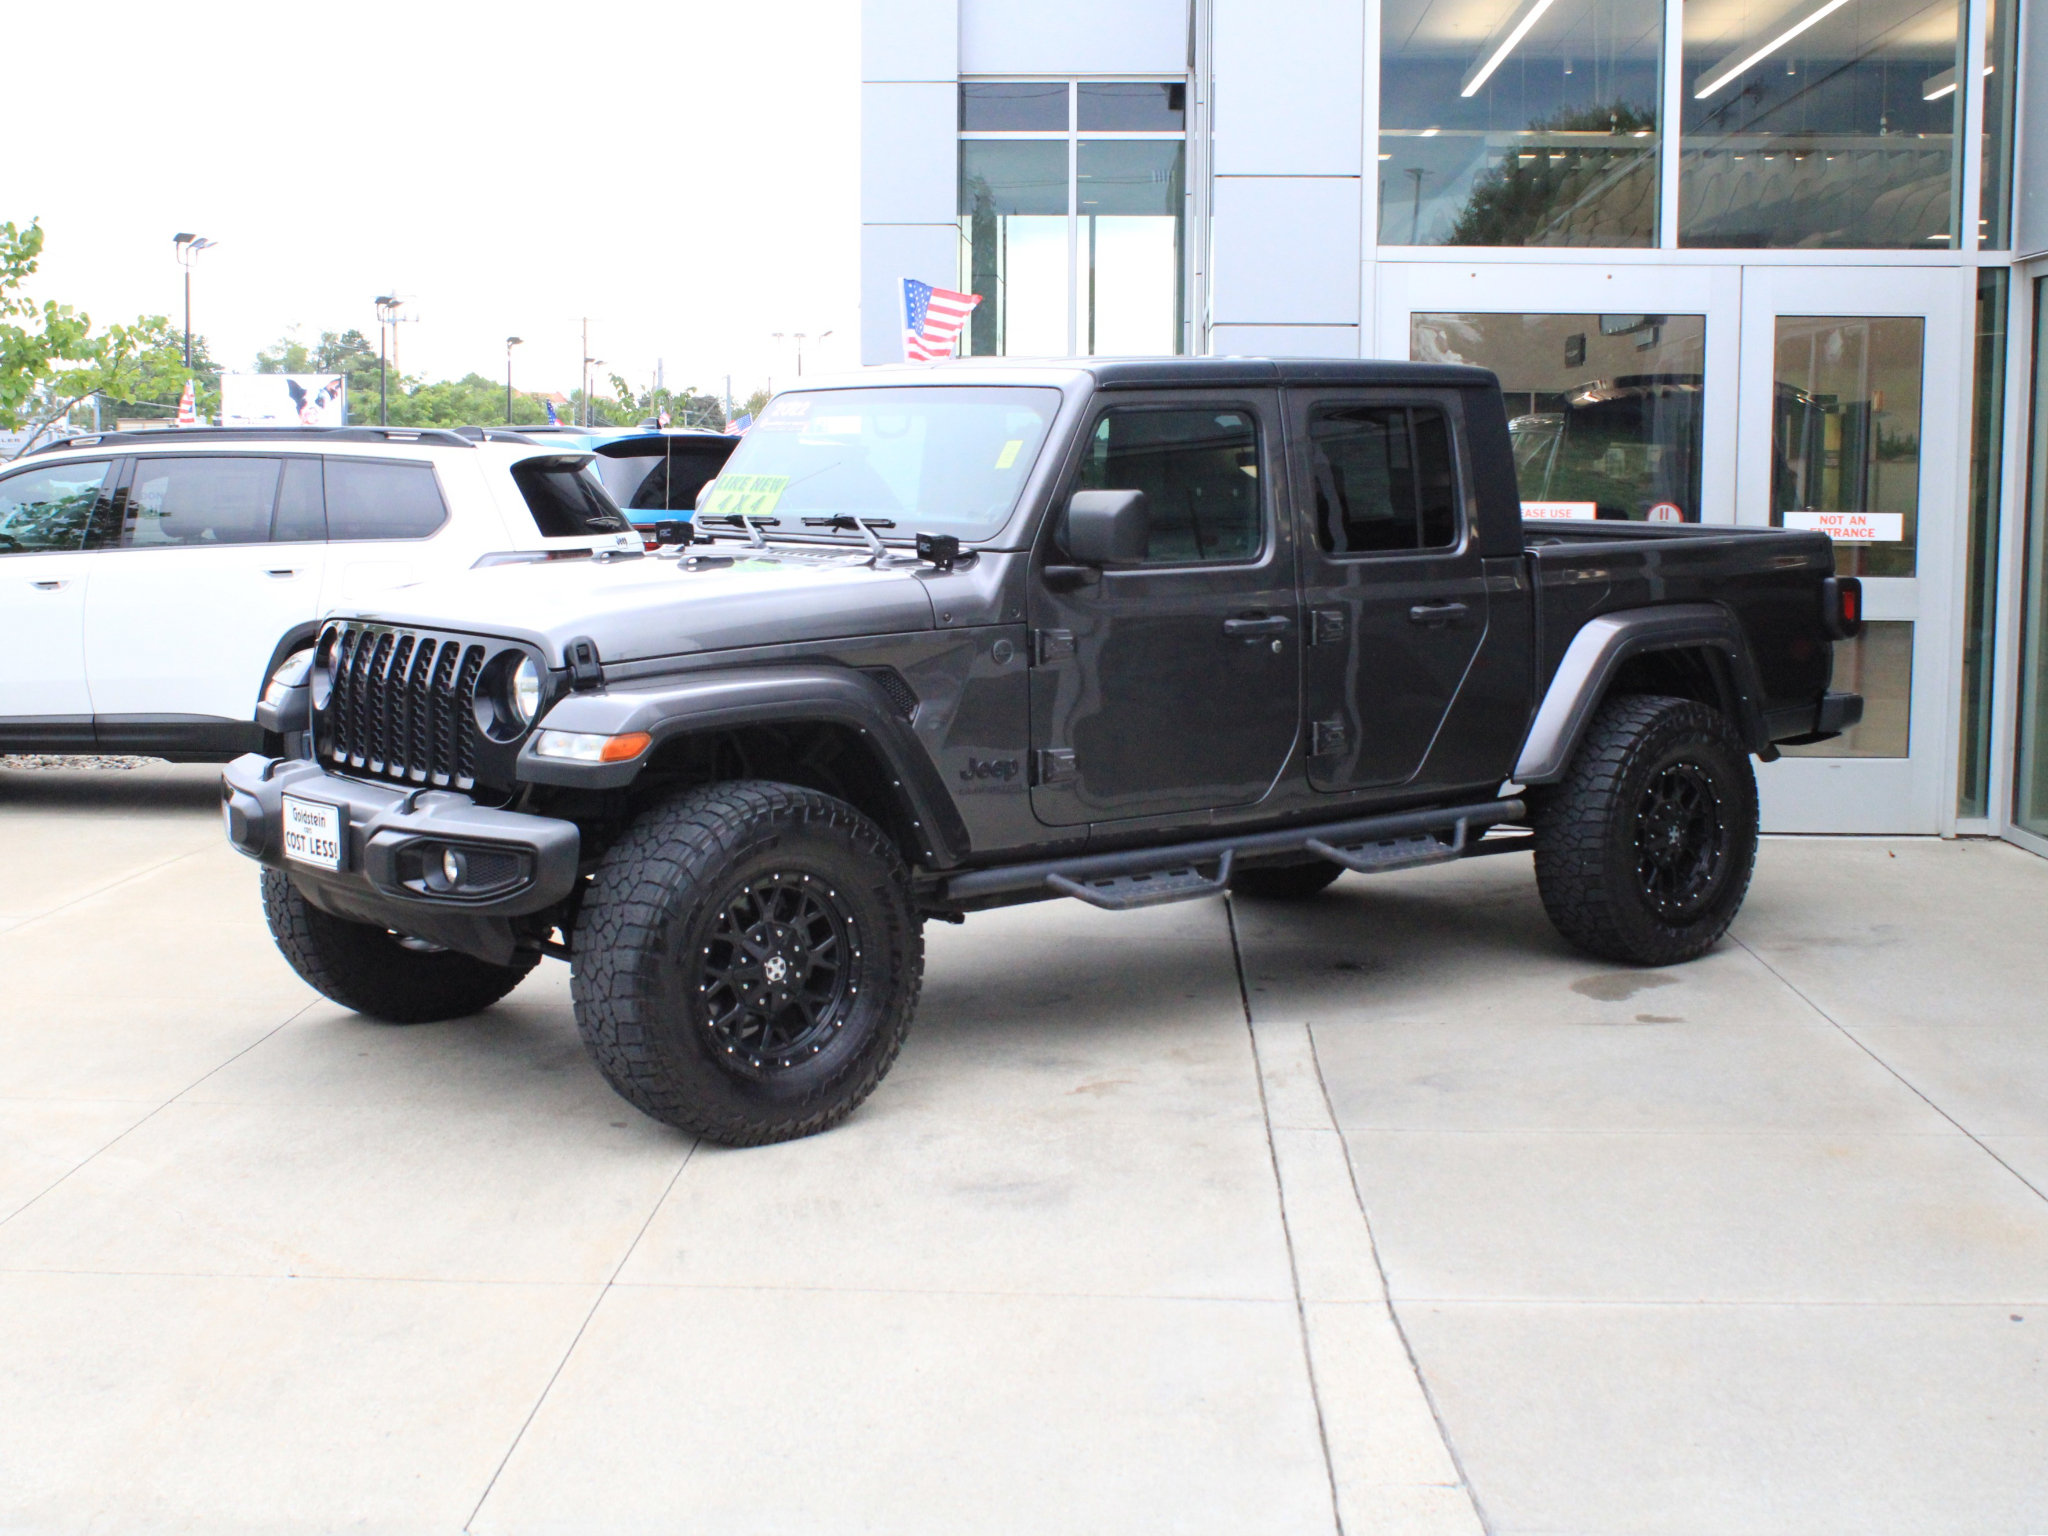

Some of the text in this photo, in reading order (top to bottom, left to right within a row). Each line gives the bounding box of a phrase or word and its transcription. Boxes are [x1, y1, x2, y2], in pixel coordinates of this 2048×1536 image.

[716, 475, 787, 493] LIKE NEW
[1521, 508, 1572, 518] EASE USE
[1819, 515, 1866, 525] NOT AN
[960, 757, 1018, 782] Jeep
[292, 807, 327, 829] Goldstein
[286, 831, 338, 860] COST LESS!
